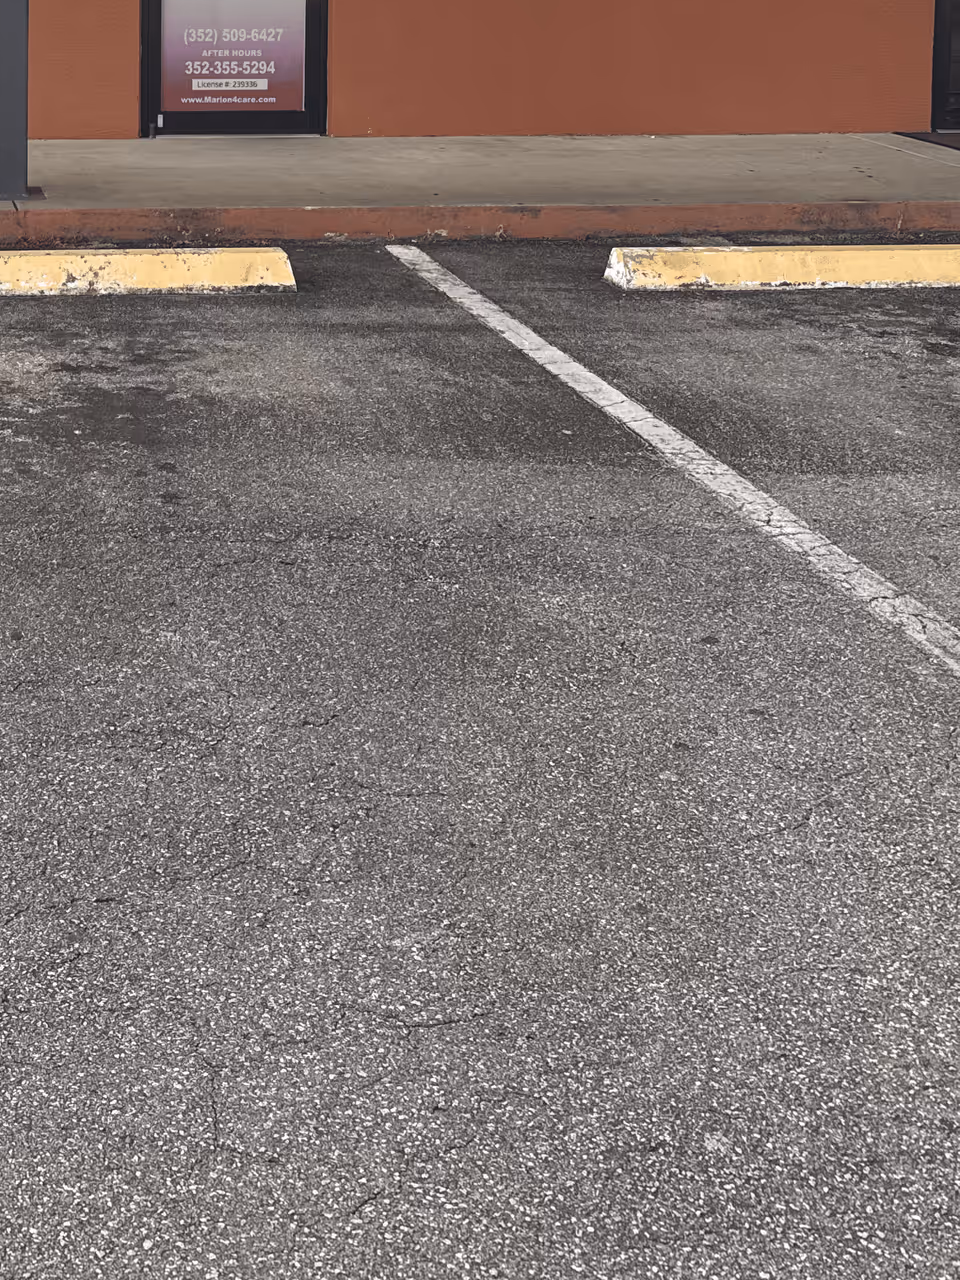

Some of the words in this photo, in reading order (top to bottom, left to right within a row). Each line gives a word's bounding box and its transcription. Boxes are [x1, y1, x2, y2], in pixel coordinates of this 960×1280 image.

[183, 28, 218, 45] (352)
[222, 28, 284, 42] 509-6427
[202, 49, 229, 57] AFTER
[232, 49, 262, 57] HOURS
[185, 61, 275, 74] 352-355-5294
[180, 96, 276, 104] www.Marion4care.com
